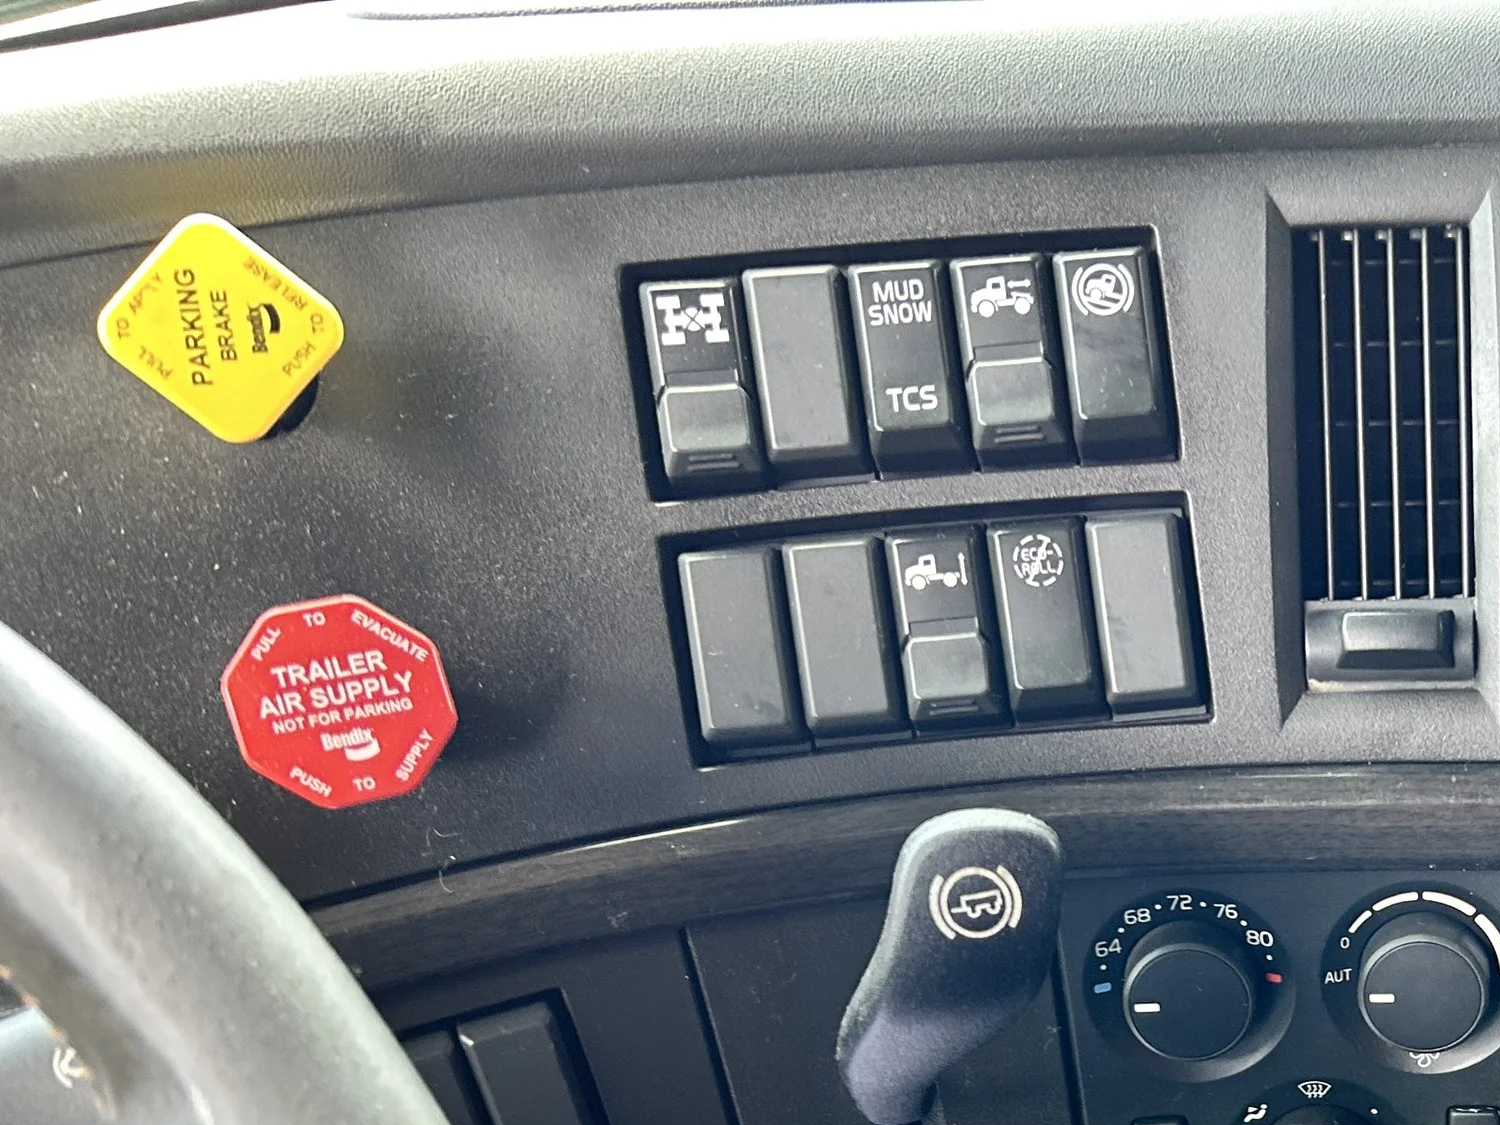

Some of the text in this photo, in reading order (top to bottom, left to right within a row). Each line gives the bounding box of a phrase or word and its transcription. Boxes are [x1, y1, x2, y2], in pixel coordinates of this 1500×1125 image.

[872, 279, 924, 303] MUD
[116, 317, 130, 340] TO
[173, 268, 214, 386] PARKING
[210, 289, 238, 361] BRAKE
[243, 256, 325, 378] PUSH TO RELEASE
[247, 302, 269, 353] Bendix
[868, 300, 932, 326] SNOW
[139, 345, 173, 380] PULL
[885, 384, 938, 413] TCS
[251, 609, 429, 662] PULL TO EVACUATE
[270, 649, 388, 689] TRAILER
[259, 671, 413, 719] AIR SUPPLY
[272, 697, 414, 734] NOT FOR PARKING
[320, 727, 375, 752] Bendix
[289, 728, 435, 798] PUSH TO SUPPLY
[1094, 895, 1274, 958] 64 68 72 76 80
[1324, 968, 1352, 984] AUT
